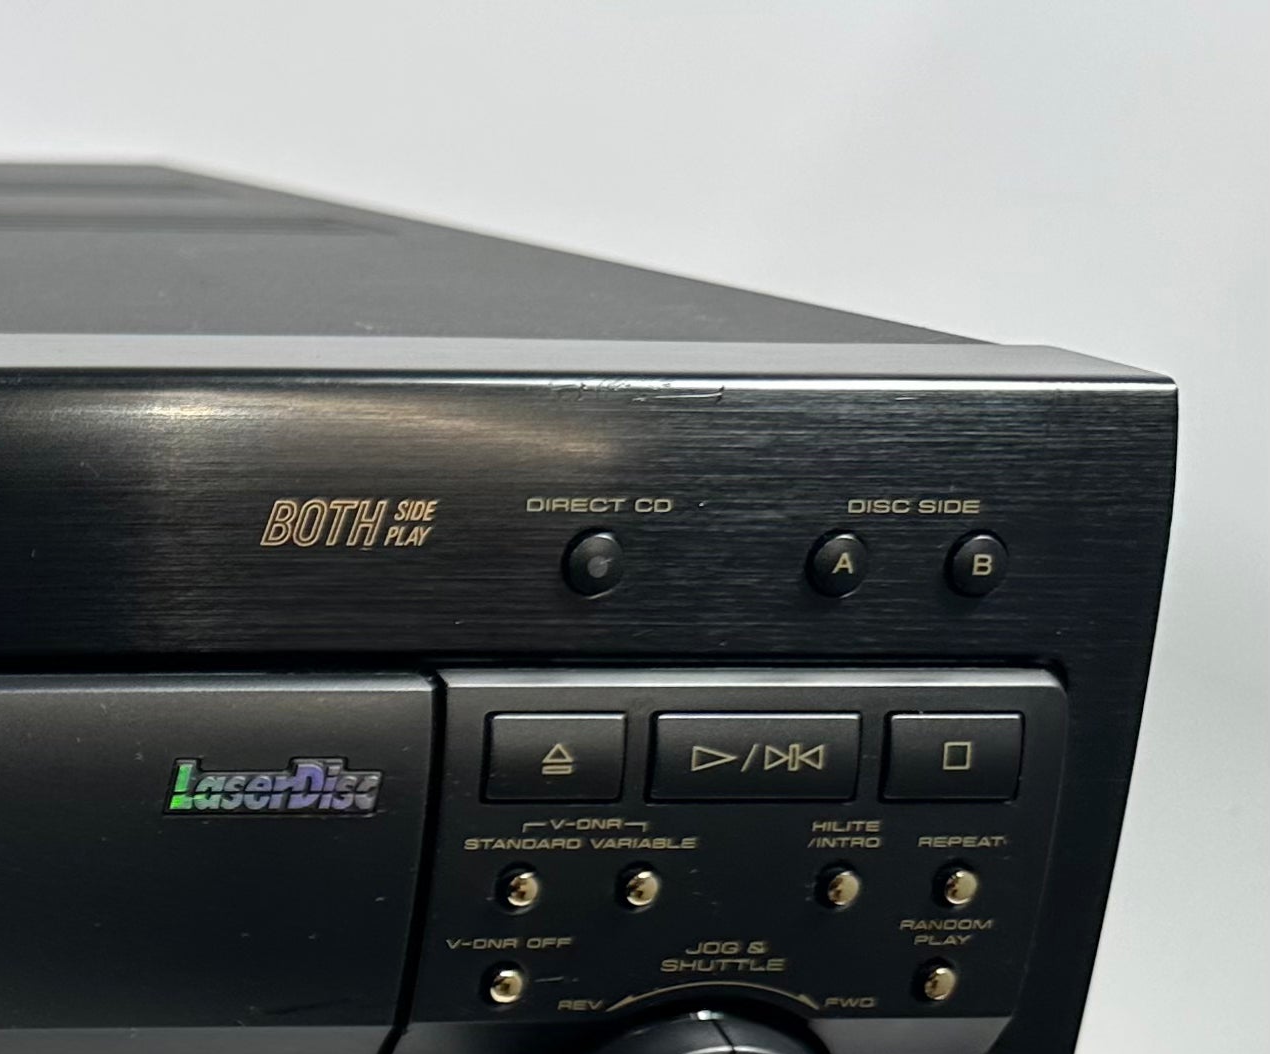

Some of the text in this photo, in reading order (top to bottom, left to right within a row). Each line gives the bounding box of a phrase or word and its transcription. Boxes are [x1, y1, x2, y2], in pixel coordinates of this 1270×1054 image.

[393, 499, 438, 522] SIDE
[526, 498, 673, 513] DIRECT CD
[847, 499, 981, 514] DISC SIDE
[260, 499, 388, 547] BOTH
[383, 526, 432, 547] PLAY
[832, 552, 854, 574] A
[972, 554, 993, 576] B
[166, 758, 382, 811] LaserDisc
[550, 818, 623, 831] V-DNR
[811, 820, 881, 832] HILITE
[464, 837, 698, 850] STANDARD VARIABLE
[917, 836, 1003, 848] REPEAT
[899, 919, 994, 931] RANDOM
[446, 936, 573, 949] V-DNR OFF
[913, 935, 972, 946] PLAY
[685, 941, 767, 955] JOG &
[660, 958, 786, 972] SHUTTLE
[558, 999, 604, 1010] REV
[824, 997, 877, 1008] FWD
